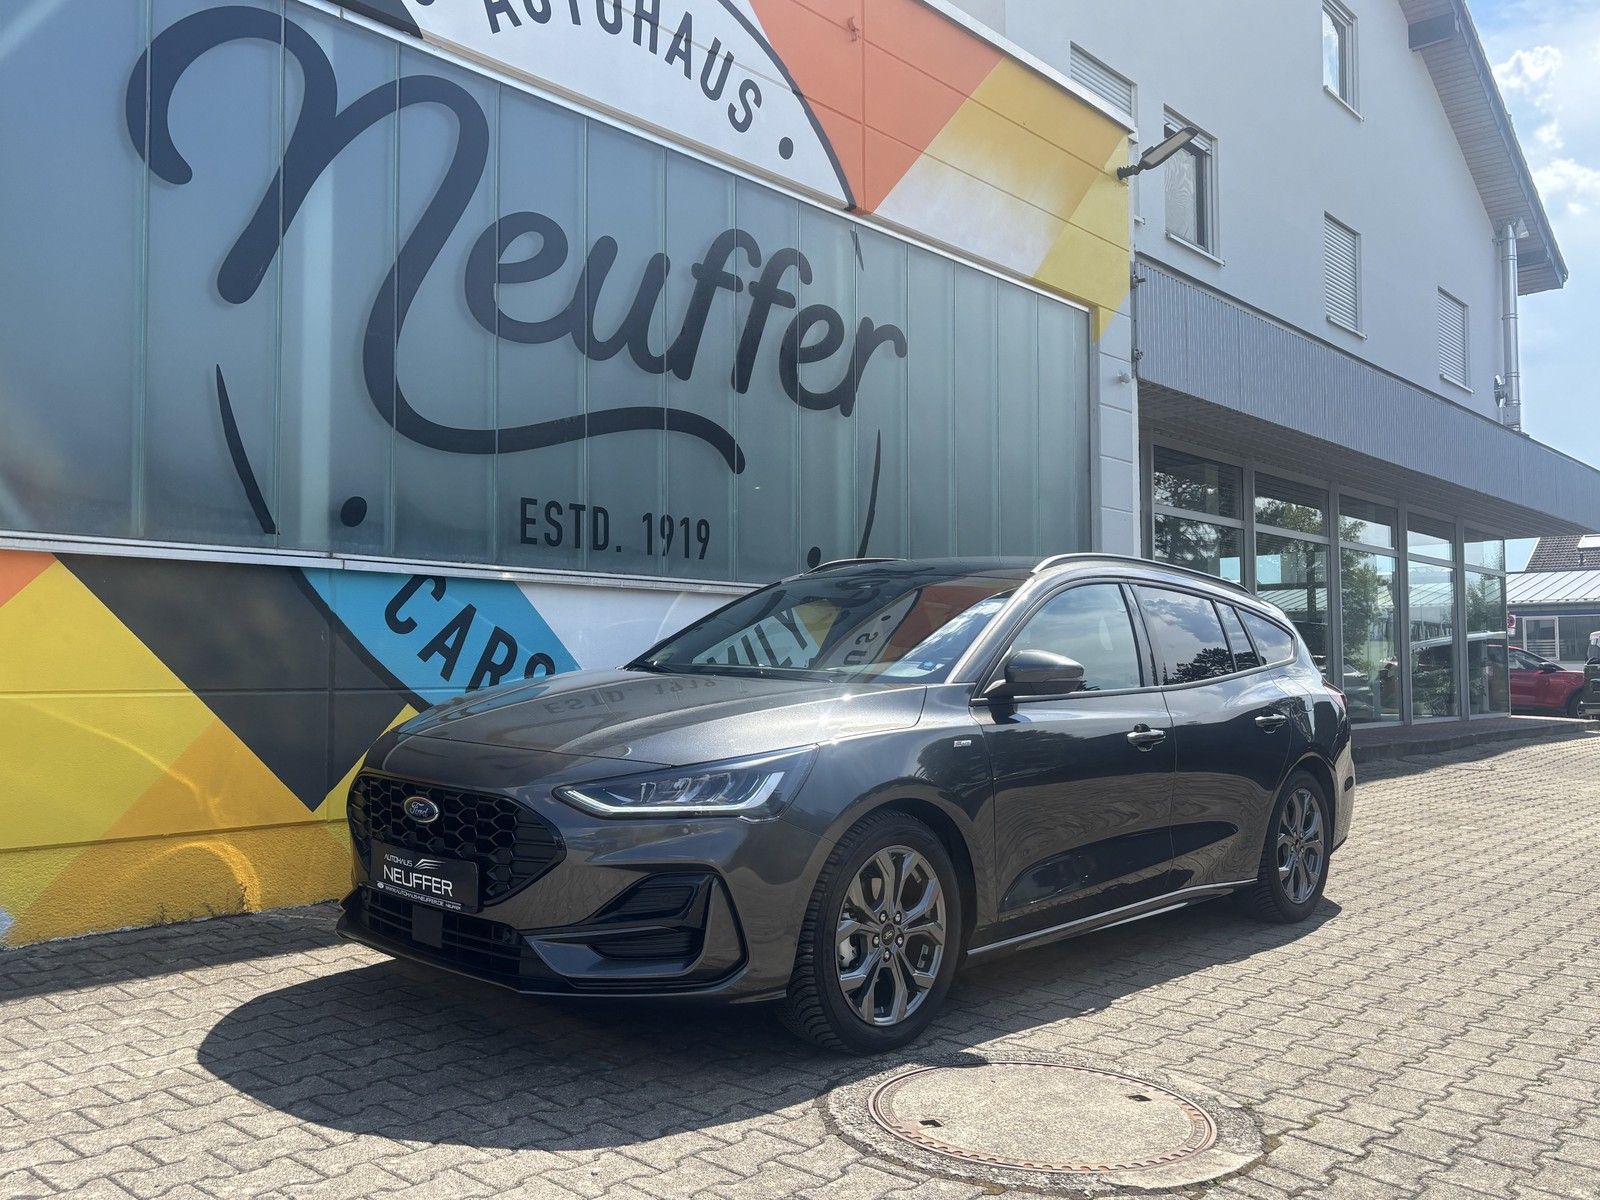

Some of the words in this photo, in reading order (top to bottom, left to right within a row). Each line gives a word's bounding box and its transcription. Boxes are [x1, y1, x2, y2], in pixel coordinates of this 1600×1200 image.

[520, 497, 622, 553] ESTD.
[642, 512, 710, 560] 1919
[384, 853, 413, 868] AUTOHAUS
[383, 864, 453, 897] NEUFFER
